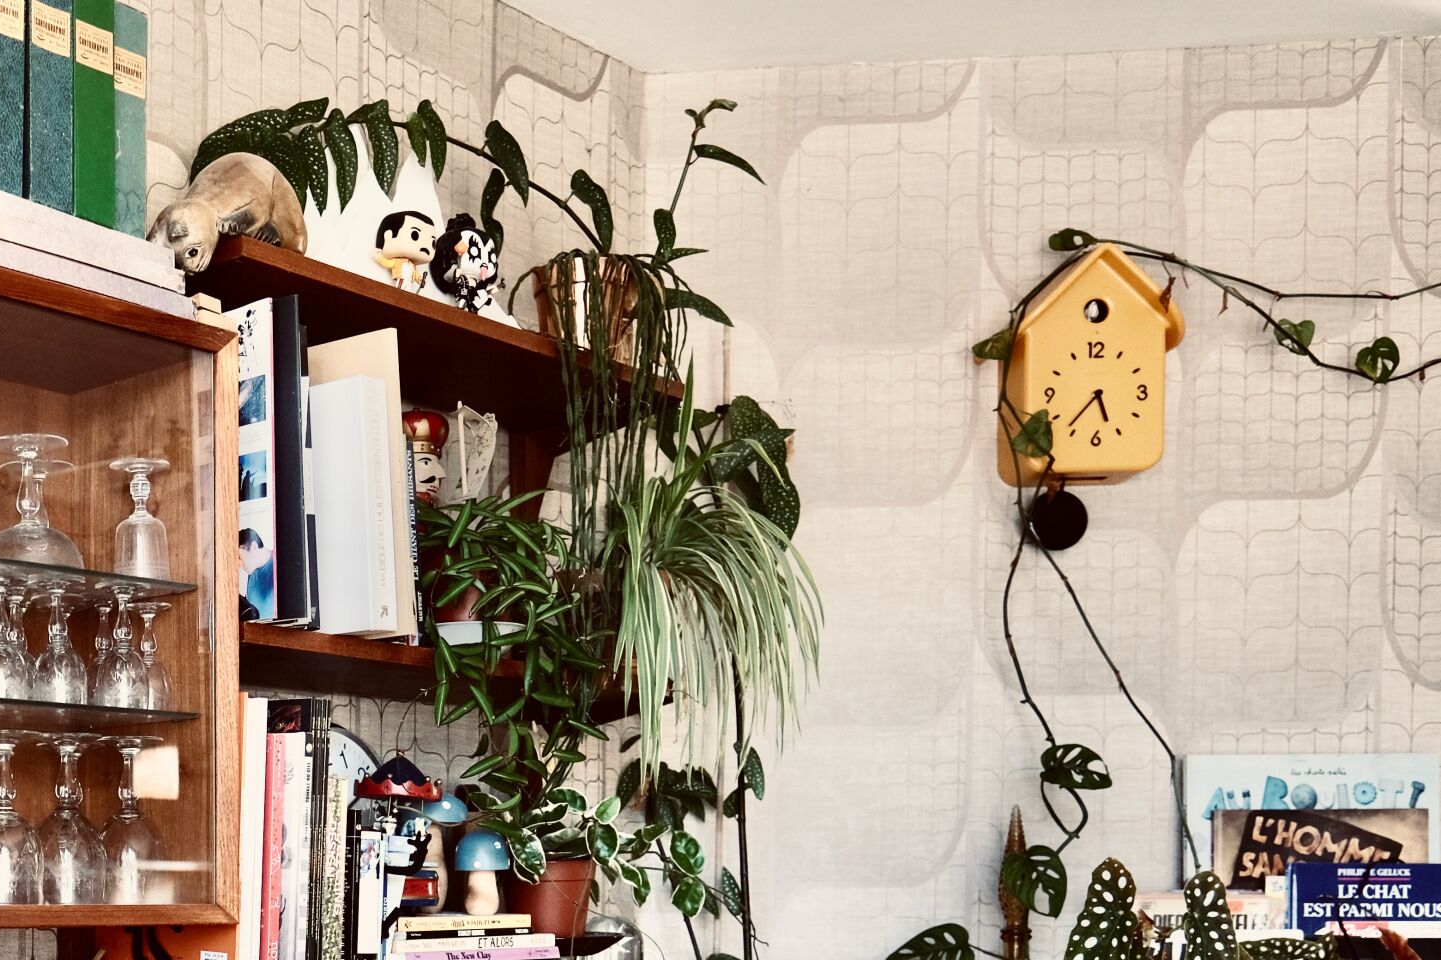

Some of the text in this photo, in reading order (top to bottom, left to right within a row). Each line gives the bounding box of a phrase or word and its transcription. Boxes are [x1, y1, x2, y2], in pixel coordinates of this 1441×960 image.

[78, 36, 109, 55] CARTOGRAPHIE
[1087, 341, 1105, 359] 12
[1044, 387, 1056, 404] 9
[1136, 384, 1148, 401] 3
[1090, 430, 1102, 447] 6
[1239, 850, 1308, 878] SAN
[1337, 868, 1411, 877] PHILIPE GELUCK
[1337, 884, 1412, 899] LE CHAT
[1303, 902, 1441, 918] EST PARMI NOUS
[490, 936, 514, 948] ALORS
[445, 950, 492, 960] The New Clay
